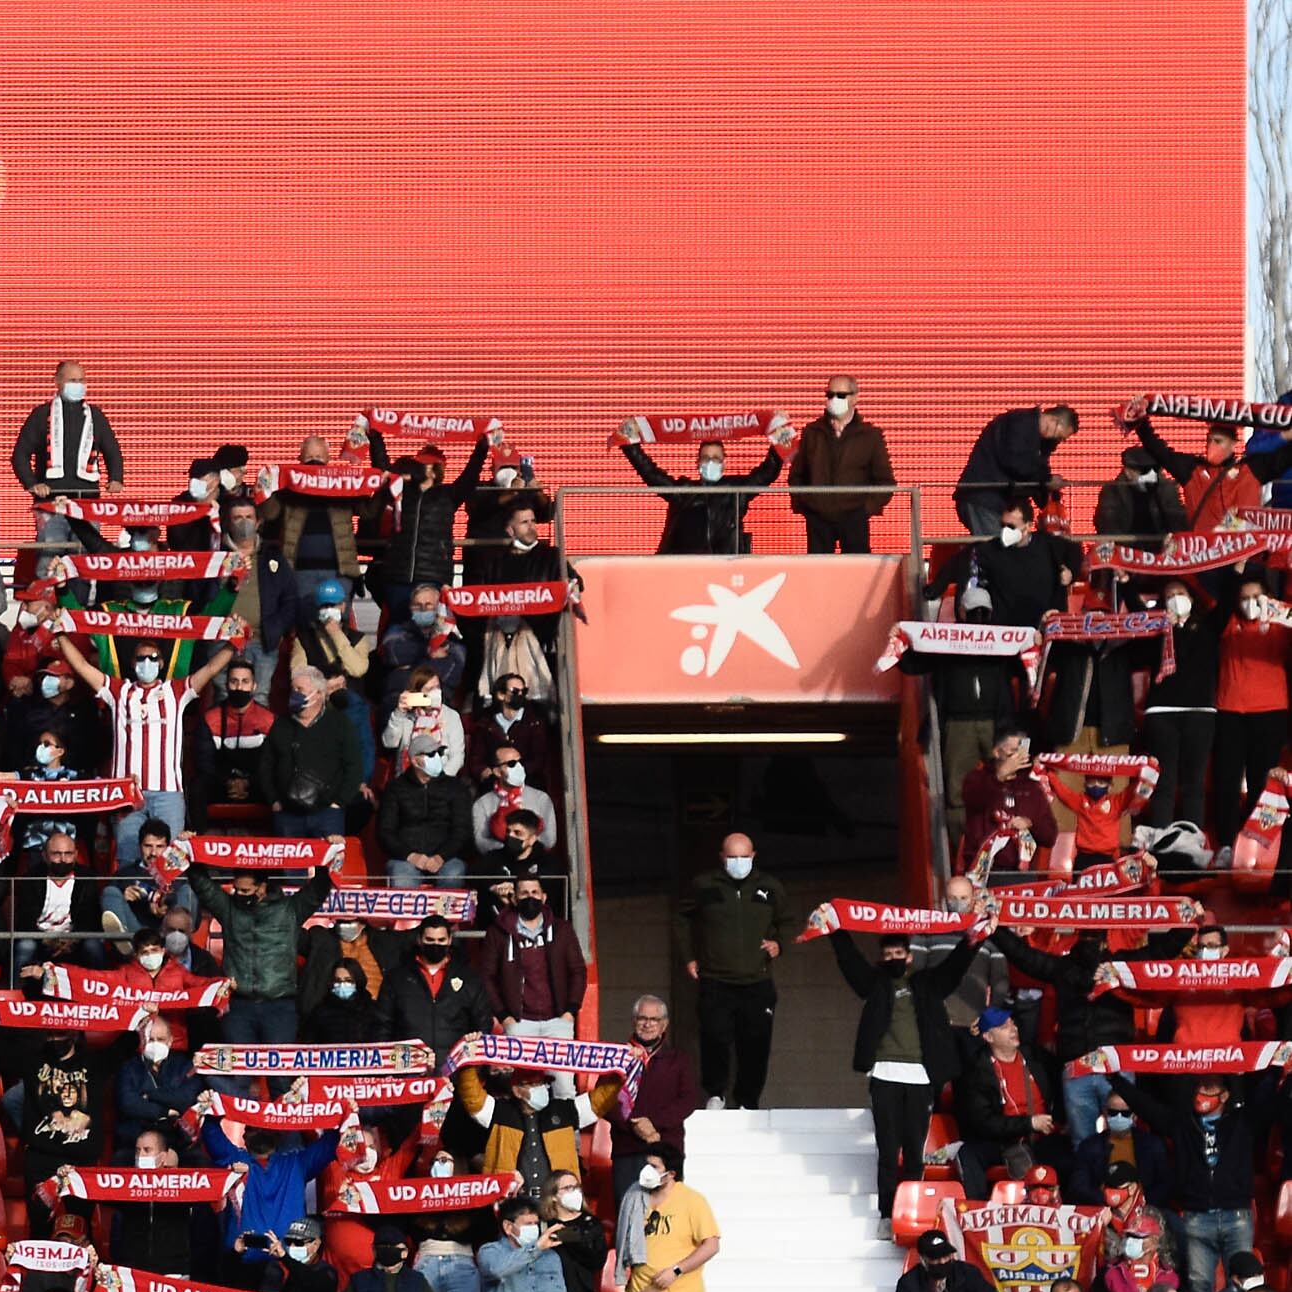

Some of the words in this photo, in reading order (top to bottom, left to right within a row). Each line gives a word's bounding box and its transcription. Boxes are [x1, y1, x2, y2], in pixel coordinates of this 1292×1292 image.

[85, 554, 114, 570] UD
[118, 550, 195, 570] ALMERÍA
[448, 591, 475, 606] UD
[478, 586, 553, 604] ALMERÍA
[204, 842, 231, 856] UD
[235, 840, 314, 858] ALMERÍA
[1145, 964, 1173, 978] UD
[1177, 961, 1260, 978] ALMERÍA
[9, 1001, 35, 1016] UD
[39, 1003, 119, 1020] ALMERÍA
[1132, 1049, 1159, 1062] UD
[1163, 1047, 1244, 1063] ALMERÍA
[234, 1098, 260, 1113] UD
[264, 1100, 343, 1116] ALMERÍA
